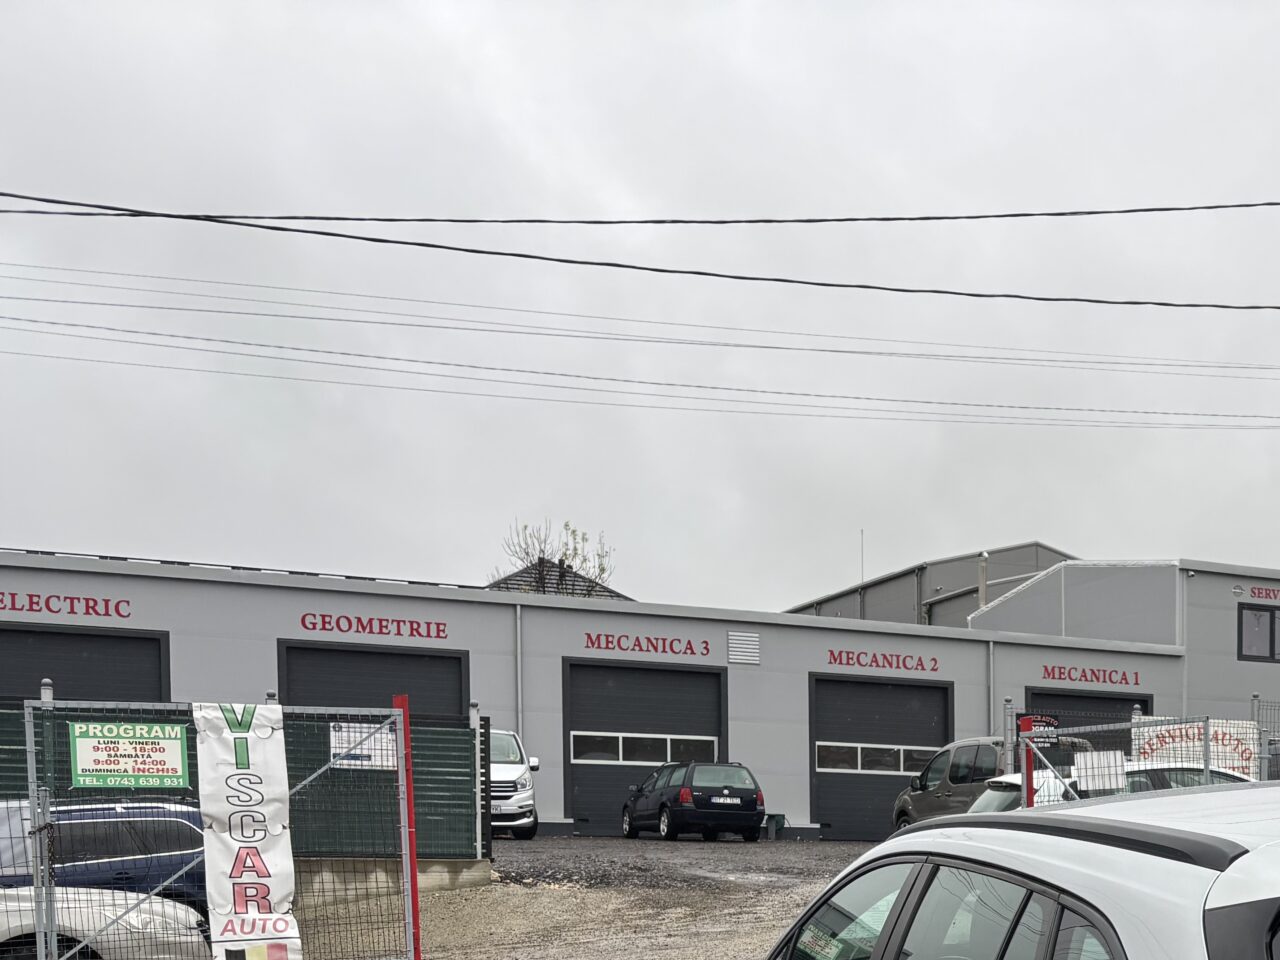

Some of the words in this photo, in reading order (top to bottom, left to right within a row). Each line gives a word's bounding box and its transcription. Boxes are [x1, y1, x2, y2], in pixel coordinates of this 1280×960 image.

[301, 613, 449, 640] GEOMETRIE
[584, 632, 697, 656] MECANICA
[700, 640, 710, 657] 3
[828, 649, 927, 672] MECANICA
[930, 658, 939, 672] 2
[1042, 665, 1130, 685] MECANICA
[1133, 671, 1141, 686] 1
[74, 724, 181, 738] PROGRAM
[92, 745, 120, 753] 9:00
[132, 766, 178, 774] ÎNCHIS
[78, 777, 103, 785] TEL:
[107, 777, 135, 786] 0743
[139, 778, 160, 786] 639
[164, 778, 183, 786] 931
[218, 704, 273, 915] VISCAR
[220, 917, 290, 937] AUTO
